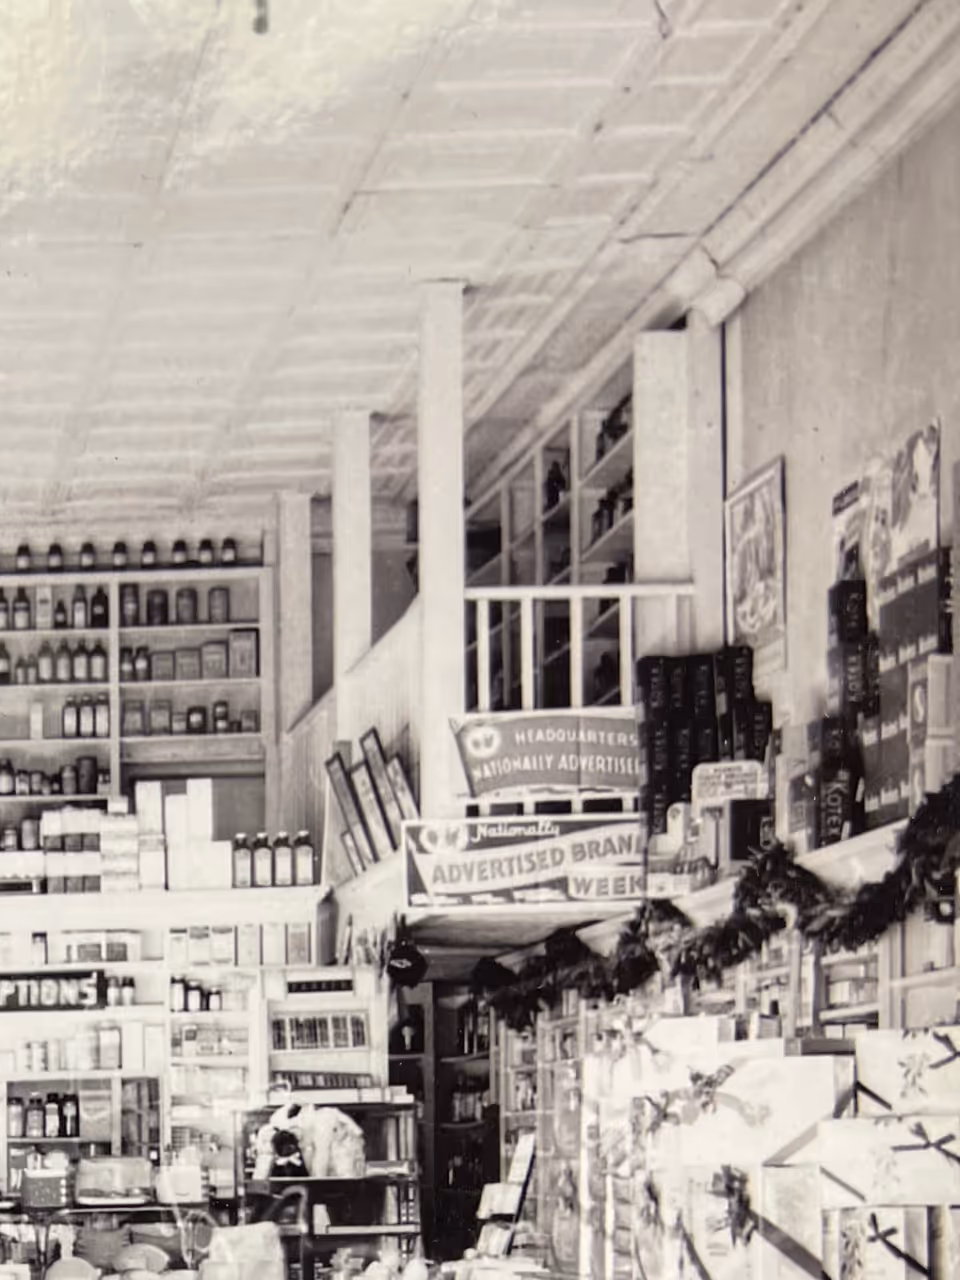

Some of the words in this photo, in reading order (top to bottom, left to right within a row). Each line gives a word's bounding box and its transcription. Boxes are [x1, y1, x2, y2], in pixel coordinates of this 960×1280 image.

[515, 728, 639, 747] HEADQUARTERS
[472, 753, 554, 780] NATIONALLY
[825, 781, 850, 840] KOTEX
[471, 820, 560, 842] Nationally
[432, 848, 565, 884] ADVERTISED
[573, 876, 641, 896] WEEK
